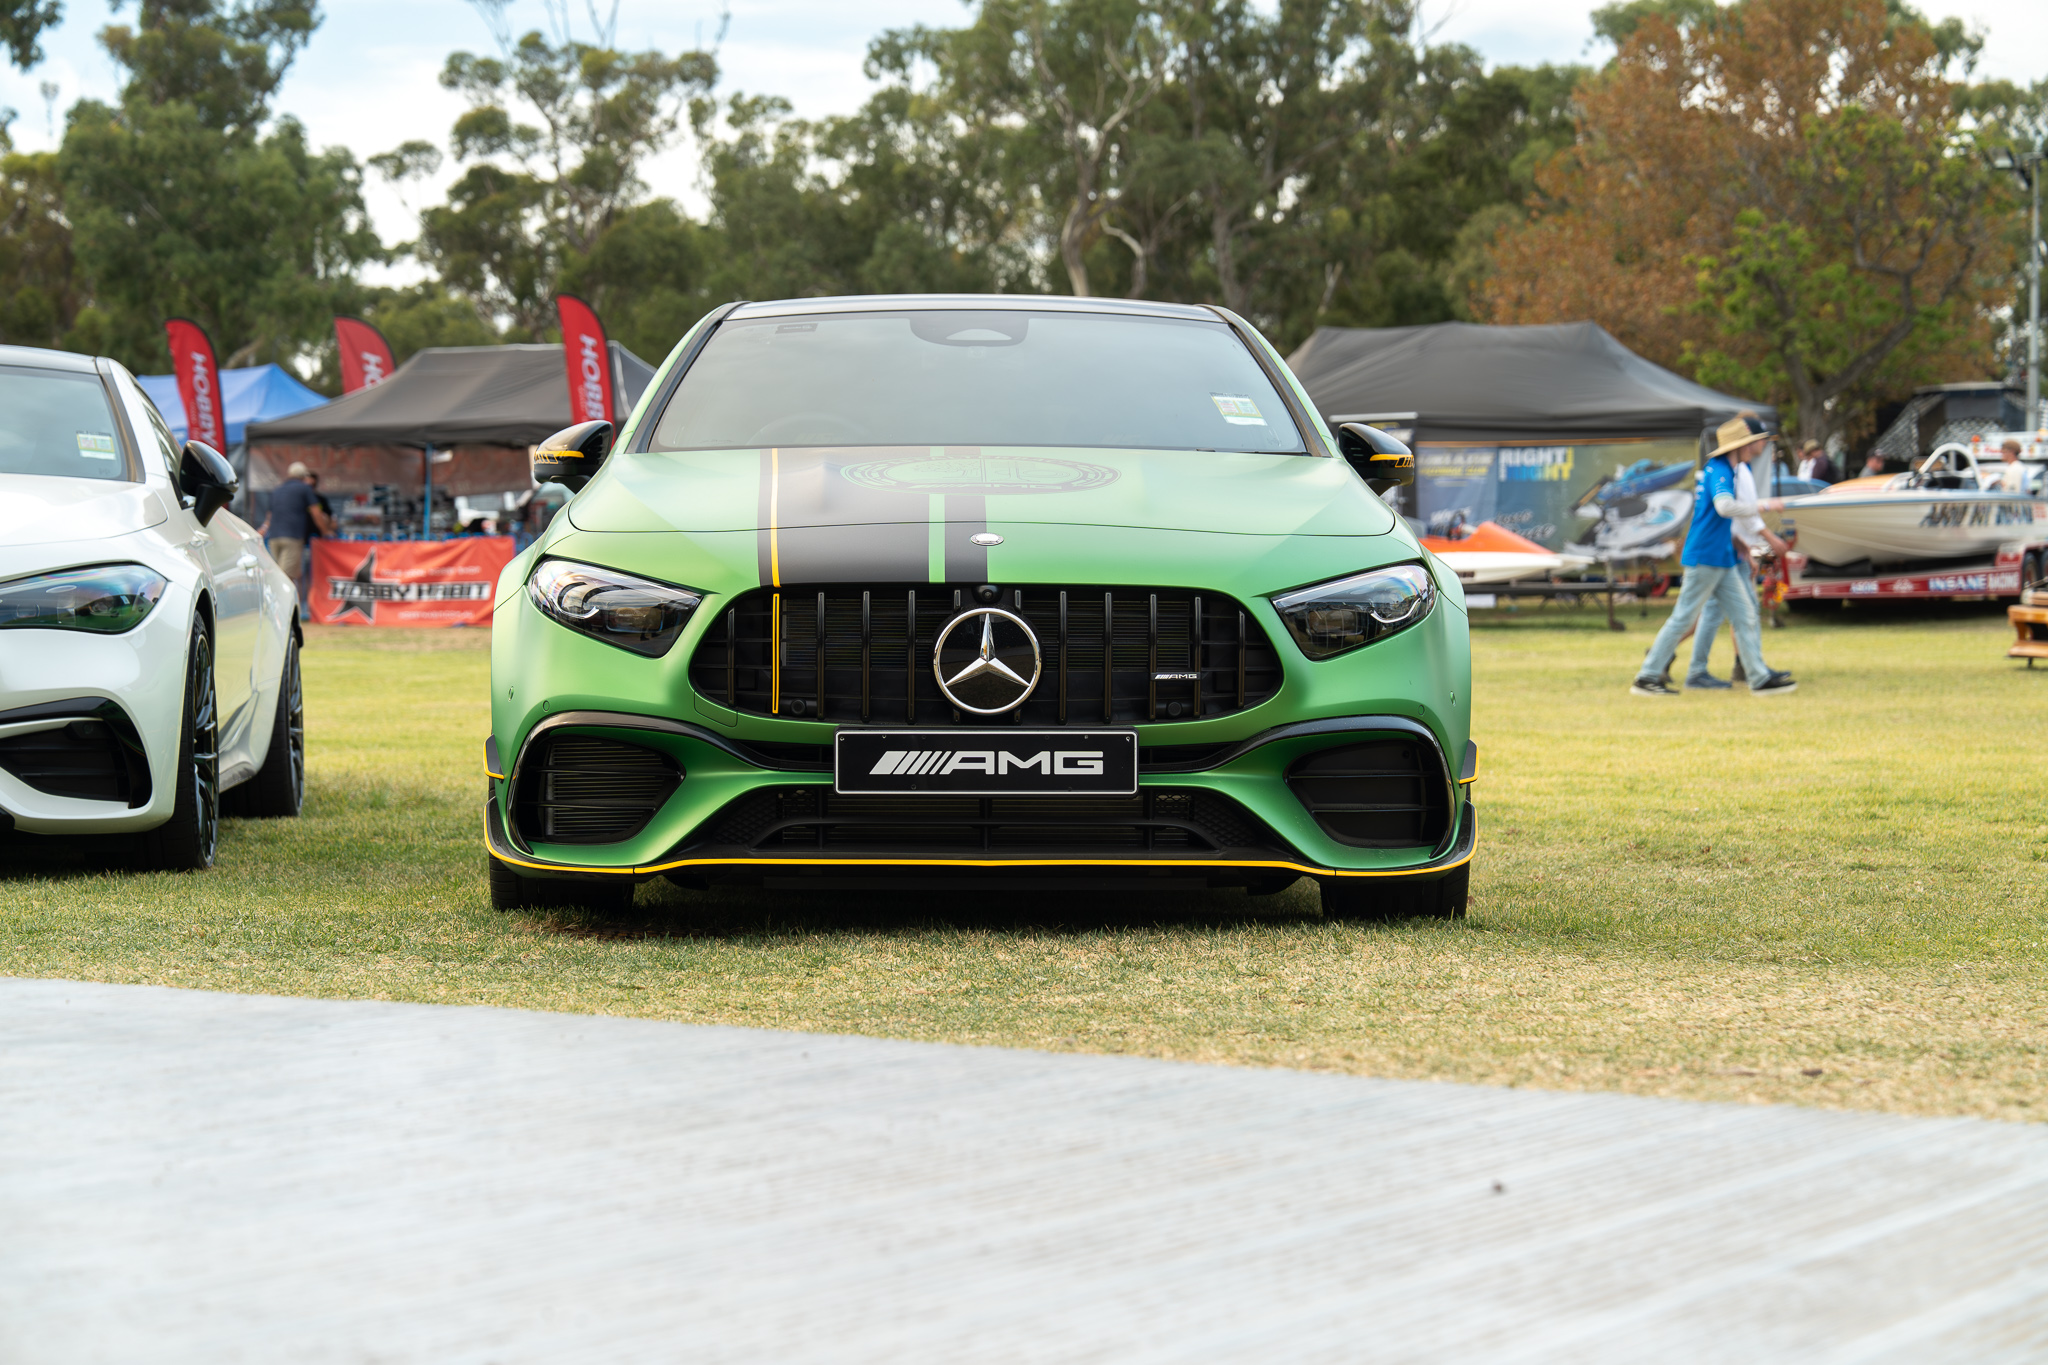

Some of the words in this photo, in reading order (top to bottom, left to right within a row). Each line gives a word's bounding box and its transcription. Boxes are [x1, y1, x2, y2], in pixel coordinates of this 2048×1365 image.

[579, 333, 605, 420] HOBB
[190, 351, 219, 448] HOBBY
[1499, 447, 1566, 466] RIGHT
[332, 582, 411, 600] HOBBY
[417, 582, 490, 600] HABIT
[1928, 574, 1987, 591] INSANE
[937, 750, 1104, 775] AMG
